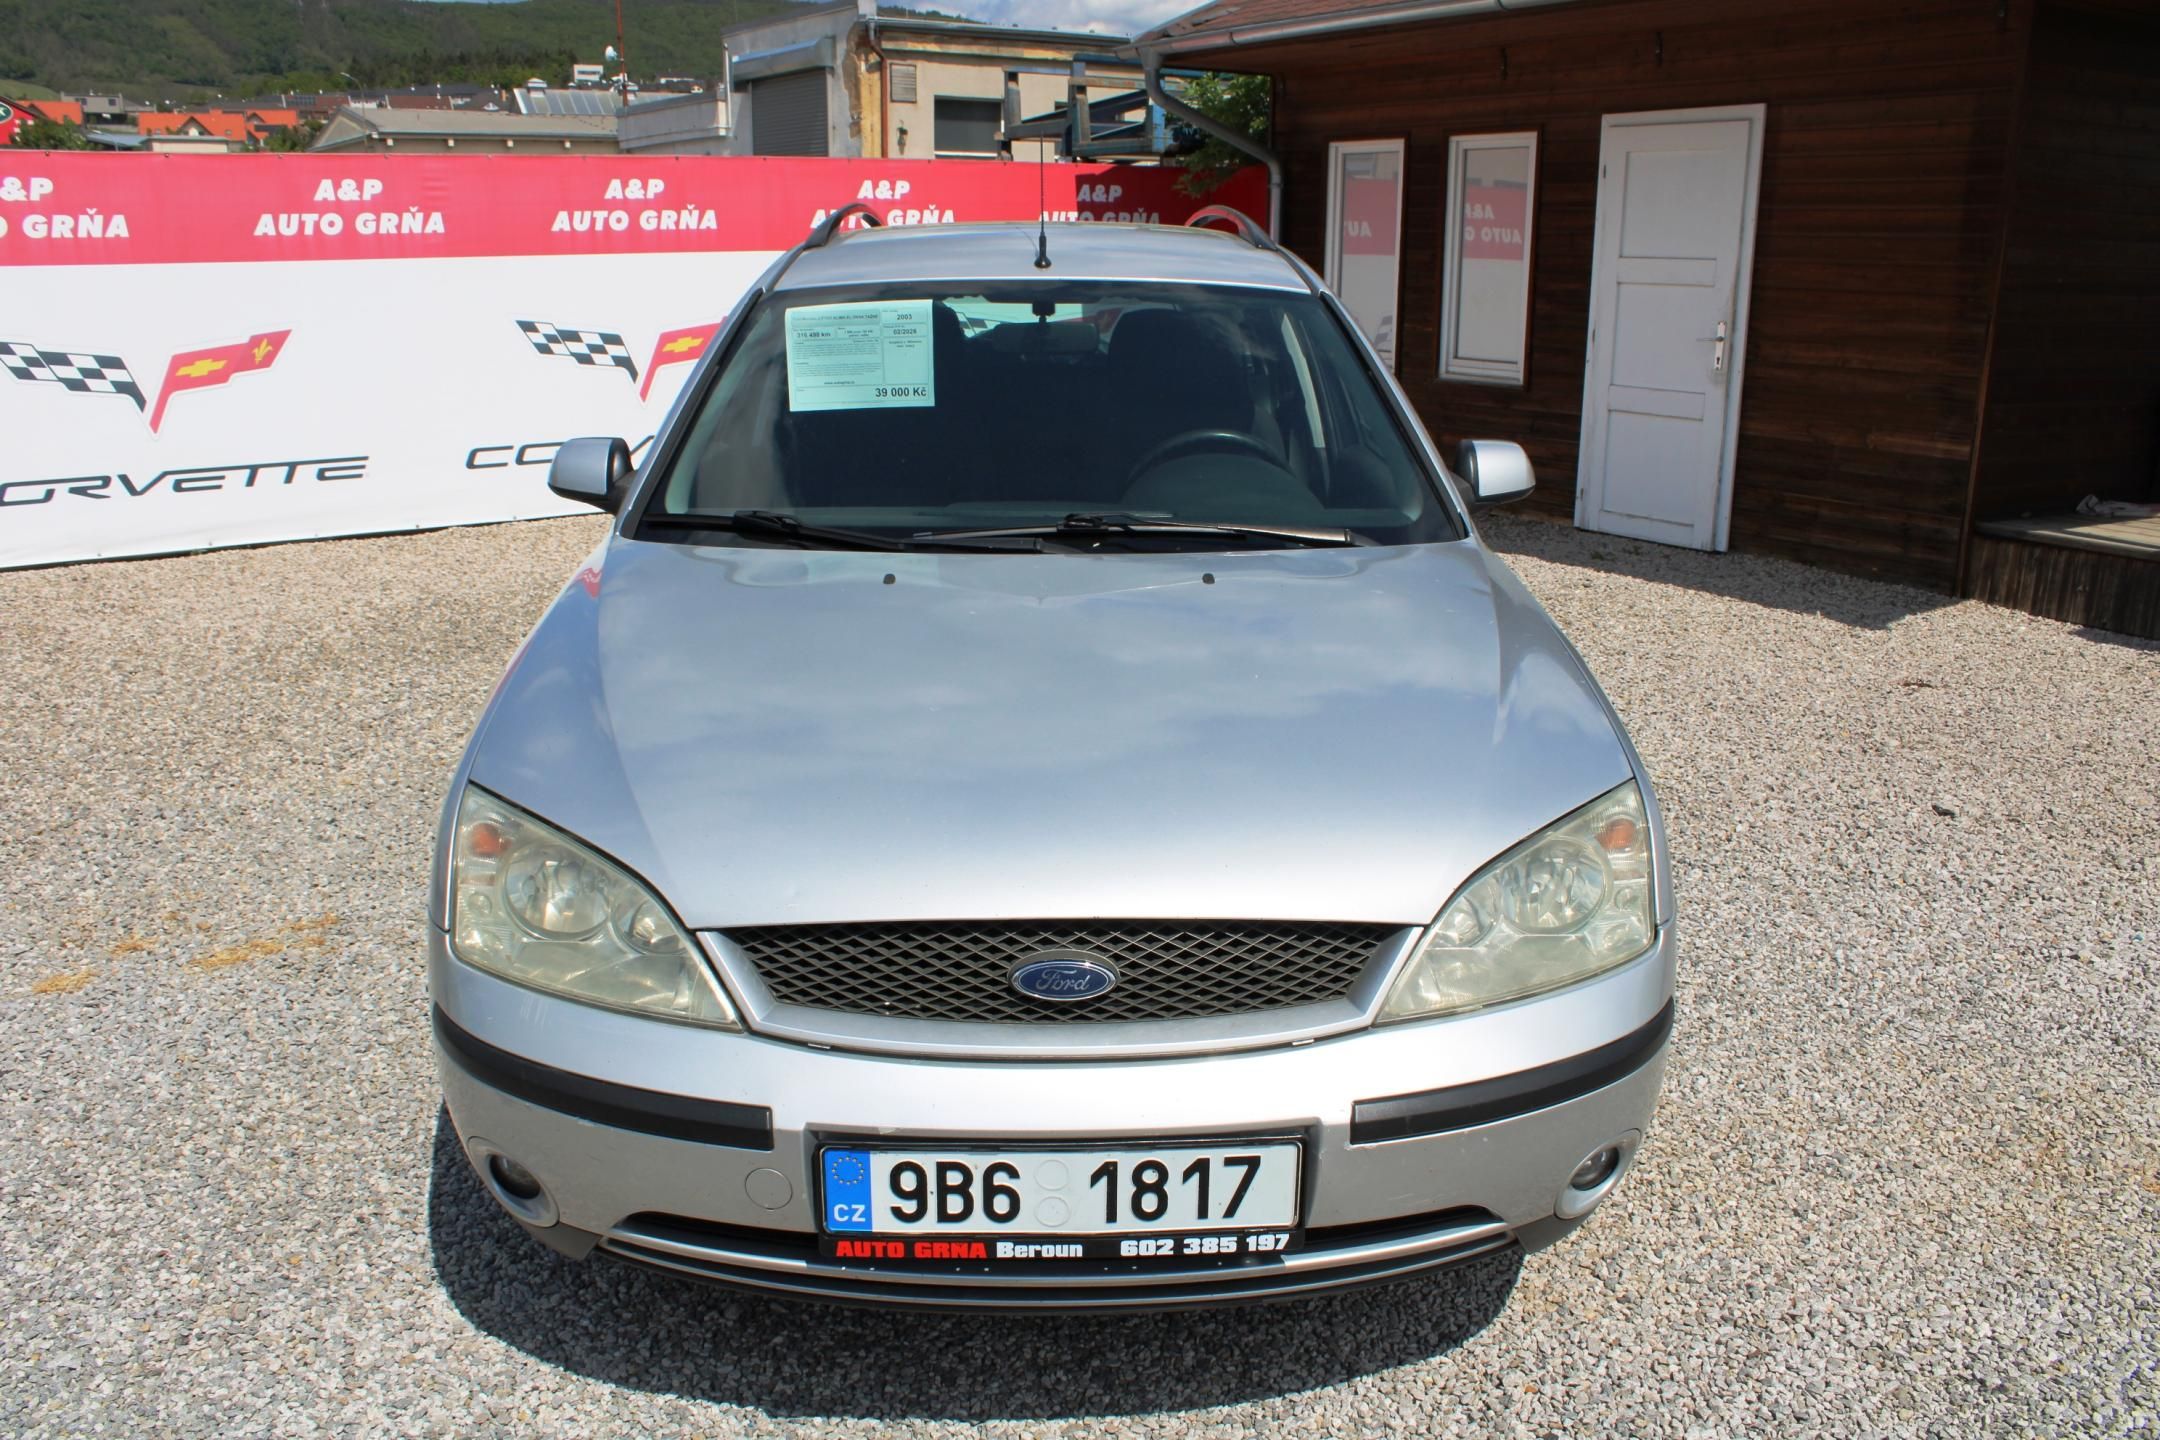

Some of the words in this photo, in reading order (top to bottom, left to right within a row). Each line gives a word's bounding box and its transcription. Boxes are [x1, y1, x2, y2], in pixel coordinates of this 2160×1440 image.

[0, 176, 54, 201] &P
[313, 178, 383, 202] A&P
[604, 178, 665, 200] A&P
[857, 179, 911, 199] A&P
[1077, 184, 1123, 202] A&P
[22, 207, 130, 239] GRŇA
[253, 212, 344, 236] AUTO
[355, 206, 446, 235] GRŇA
[551, 210, 630, 232] AUTO
[639, 203, 718, 231] GRŇA
[887, 204, 955, 227] GRŇA
[896, 313, 913, 321] 2003
[875, 387, 887, 397] 39
[891, 387, 910, 397] 000
[913, 386, 927, 396] Kč
[0, 456, 369, 506] ORVETTE
[1036, 968, 1091, 991] Ford
[889, 1160, 1021, 1224] 9B6
[1090, 1155, 1262, 1224] 1817
[833, 1203, 866, 1222] CZ
[836, 1240, 905, 1259] AUTO
[914, 1241, 988, 1259] GRNA
[996, 1241, 1083, 1259] Beroun
[1120, 1239, 1174, 1256] 602
[1183, 1236, 1238, 1255] 385
[1246, 1233, 1290, 1251] 197
